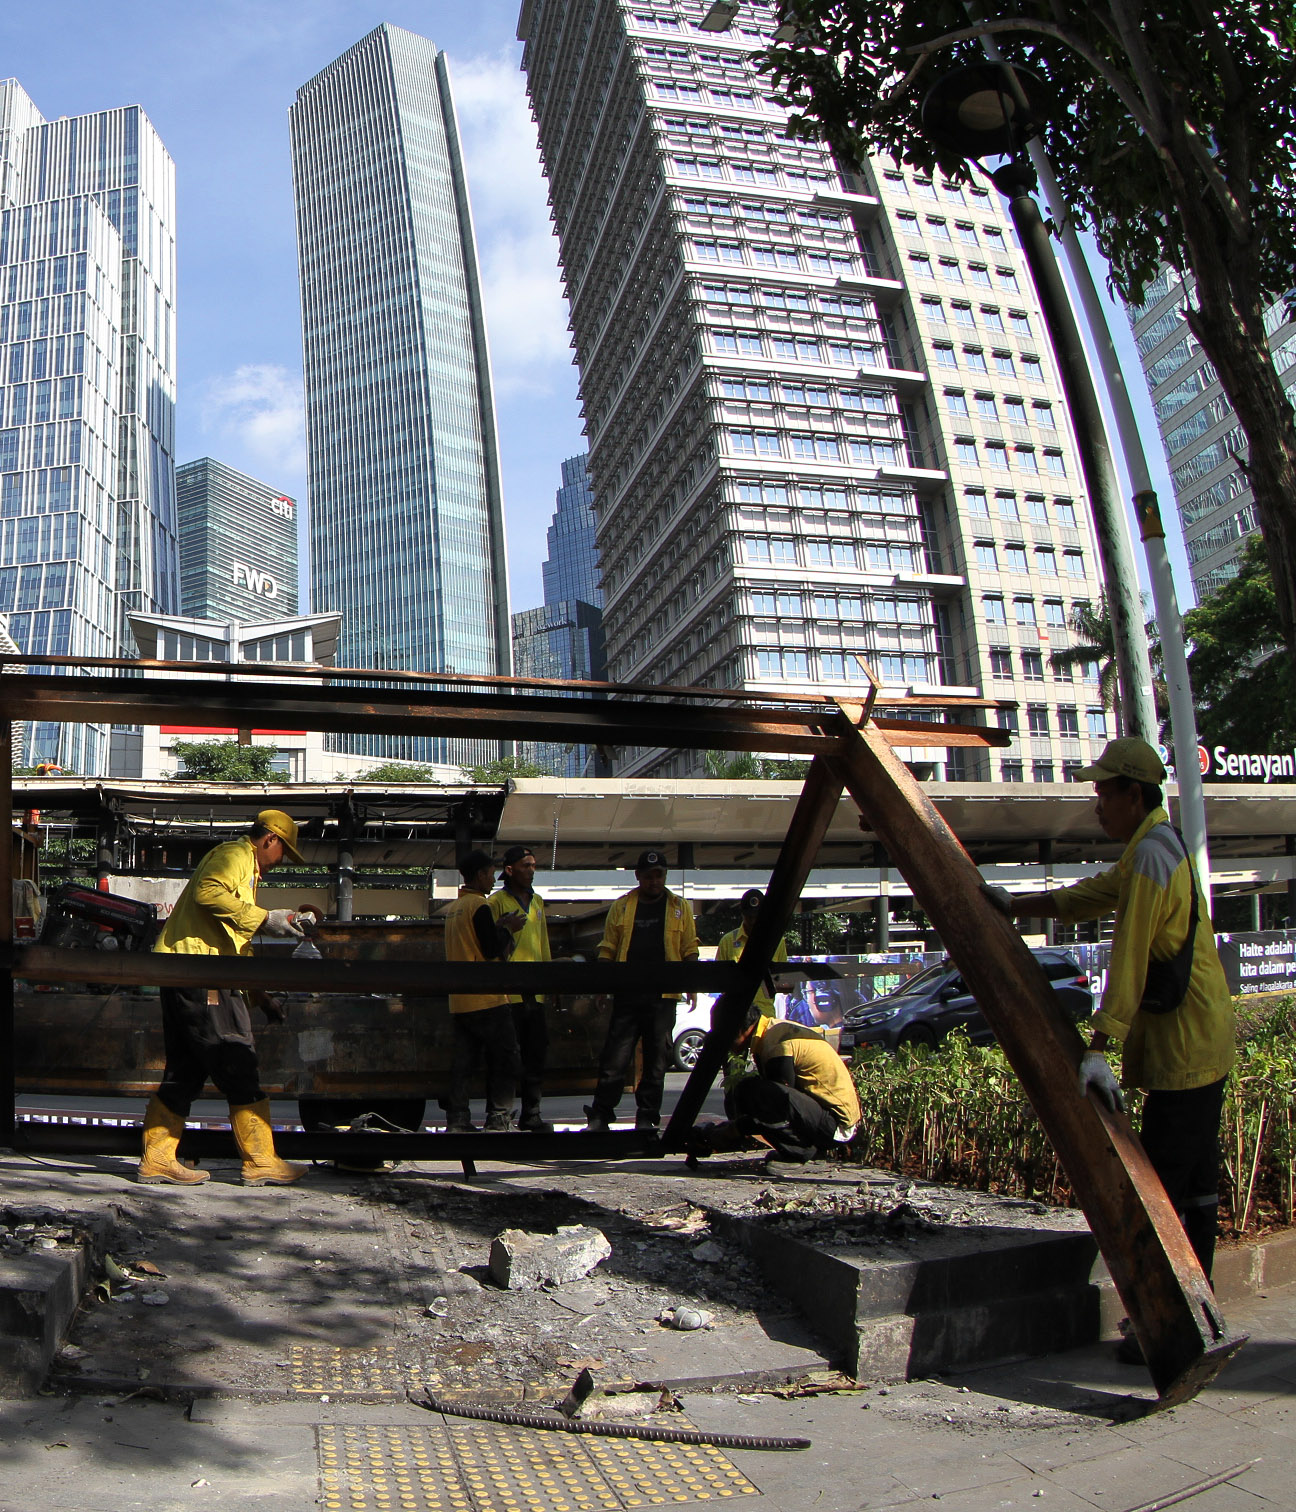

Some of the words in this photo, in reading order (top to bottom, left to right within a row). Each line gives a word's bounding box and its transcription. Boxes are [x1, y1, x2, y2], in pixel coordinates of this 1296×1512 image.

[271, 496, 293, 520] citi
[233, 559, 277, 599] FWD
[1214, 745, 1294, 784] Senayan
[1239, 942, 1264, 958] Halte
[1265, 940, 1293, 956] adalah
[1239, 962, 1257, 977] kita
[1258, 961, 1284, 976] dalam
